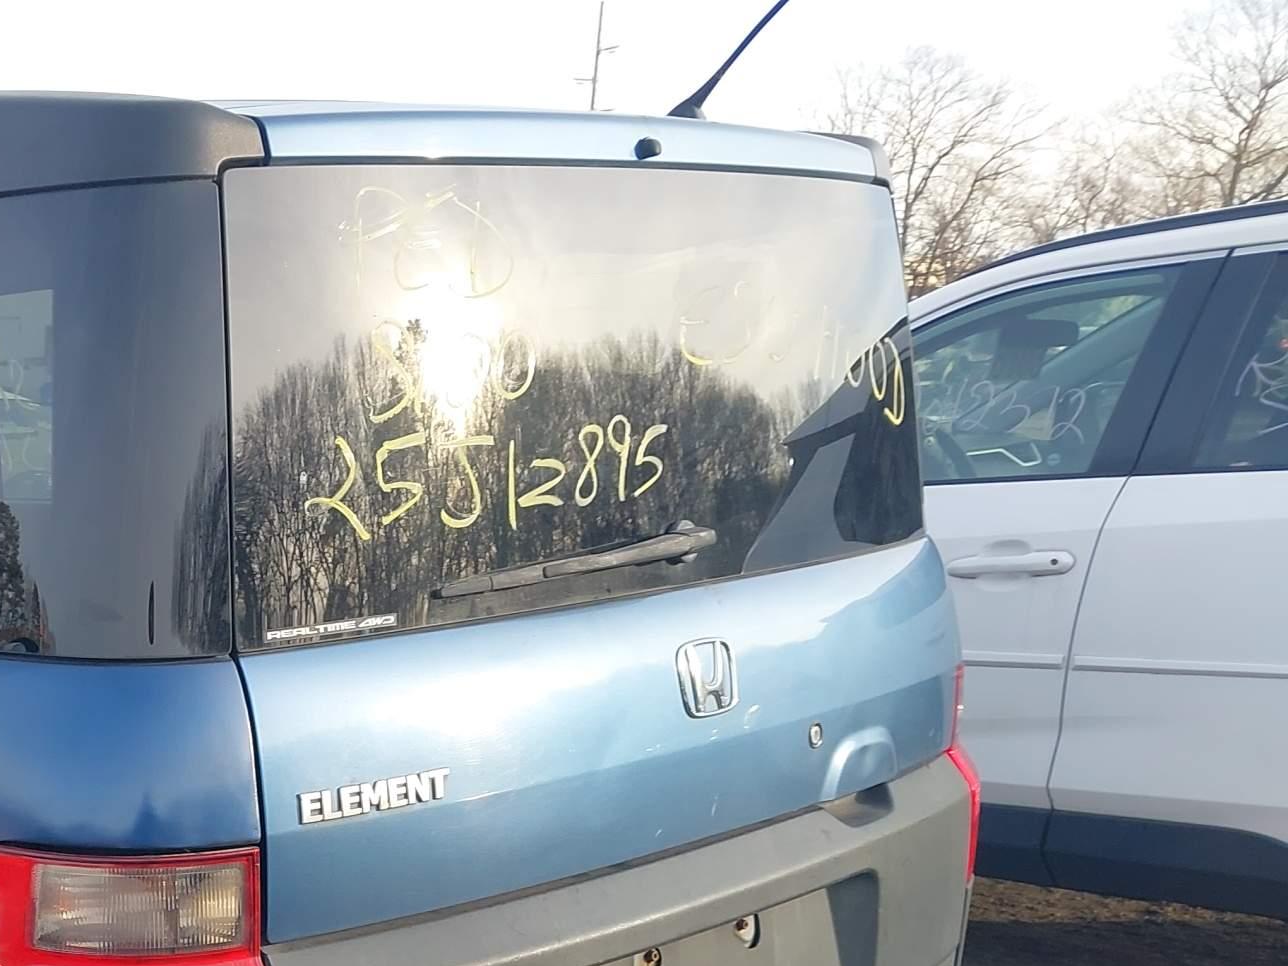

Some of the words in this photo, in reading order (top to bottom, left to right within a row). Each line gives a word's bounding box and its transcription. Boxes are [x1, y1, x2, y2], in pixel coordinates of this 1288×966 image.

[304, 414, 668, 541] 25J12895
[358, 615, 395, 628] 4WD
[296, 767, 451, 825] ELEMENT
